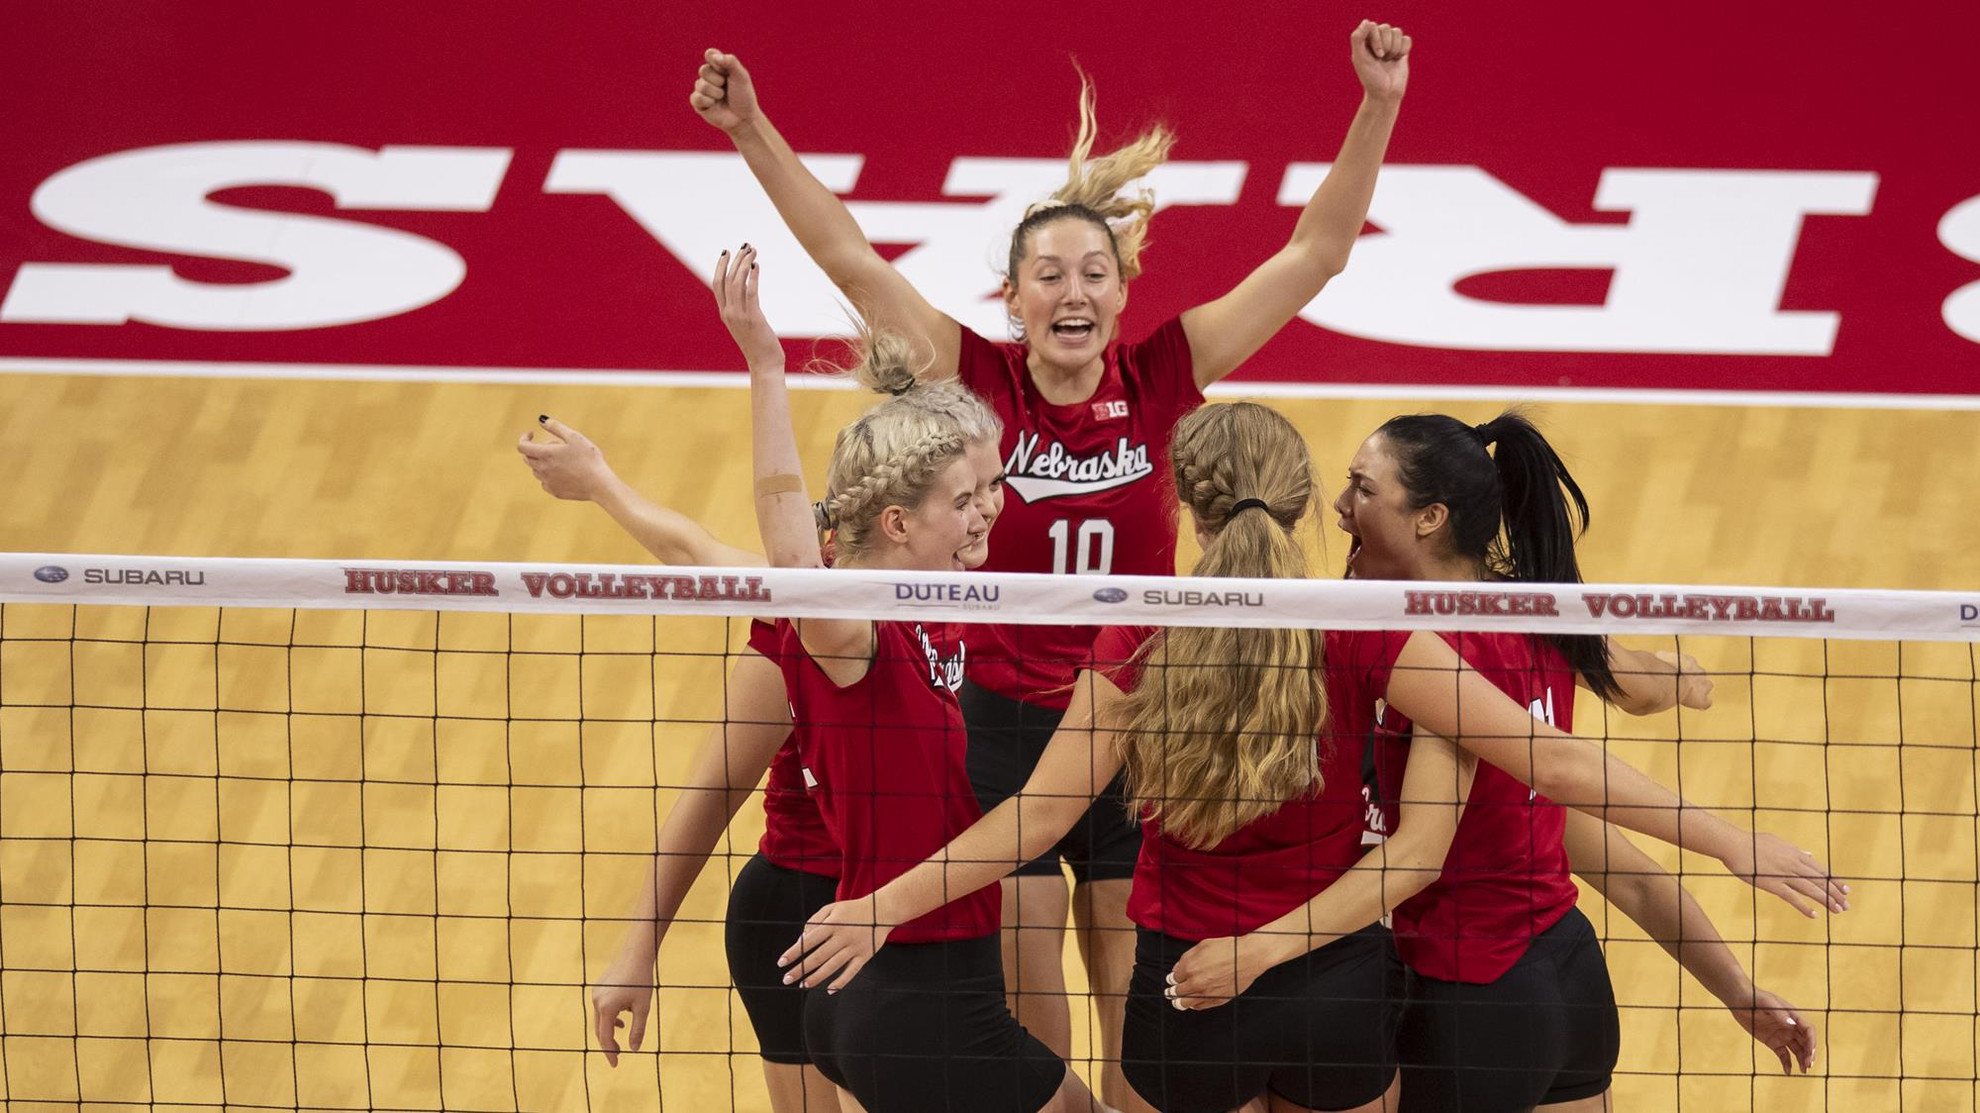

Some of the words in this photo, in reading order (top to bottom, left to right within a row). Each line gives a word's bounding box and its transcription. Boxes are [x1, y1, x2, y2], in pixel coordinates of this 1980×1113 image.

[0, 139, 1980, 358] RAS
[1003, 428, 1152, 483] Nebraska
[1048, 518, 1115, 575] 10
[84, 568, 205, 586] SUBARU
[344, 568, 499, 596] HUSKER
[521, 572, 771, 602] VOLLEYBALL
[895, 583, 1000, 602] DUTEAU
[1143, 590, 1263, 607] SUBARU
[1404, 590, 1559, 617] HUSKER
[1582, 594, 1835, 623] VOLLEYBALL
